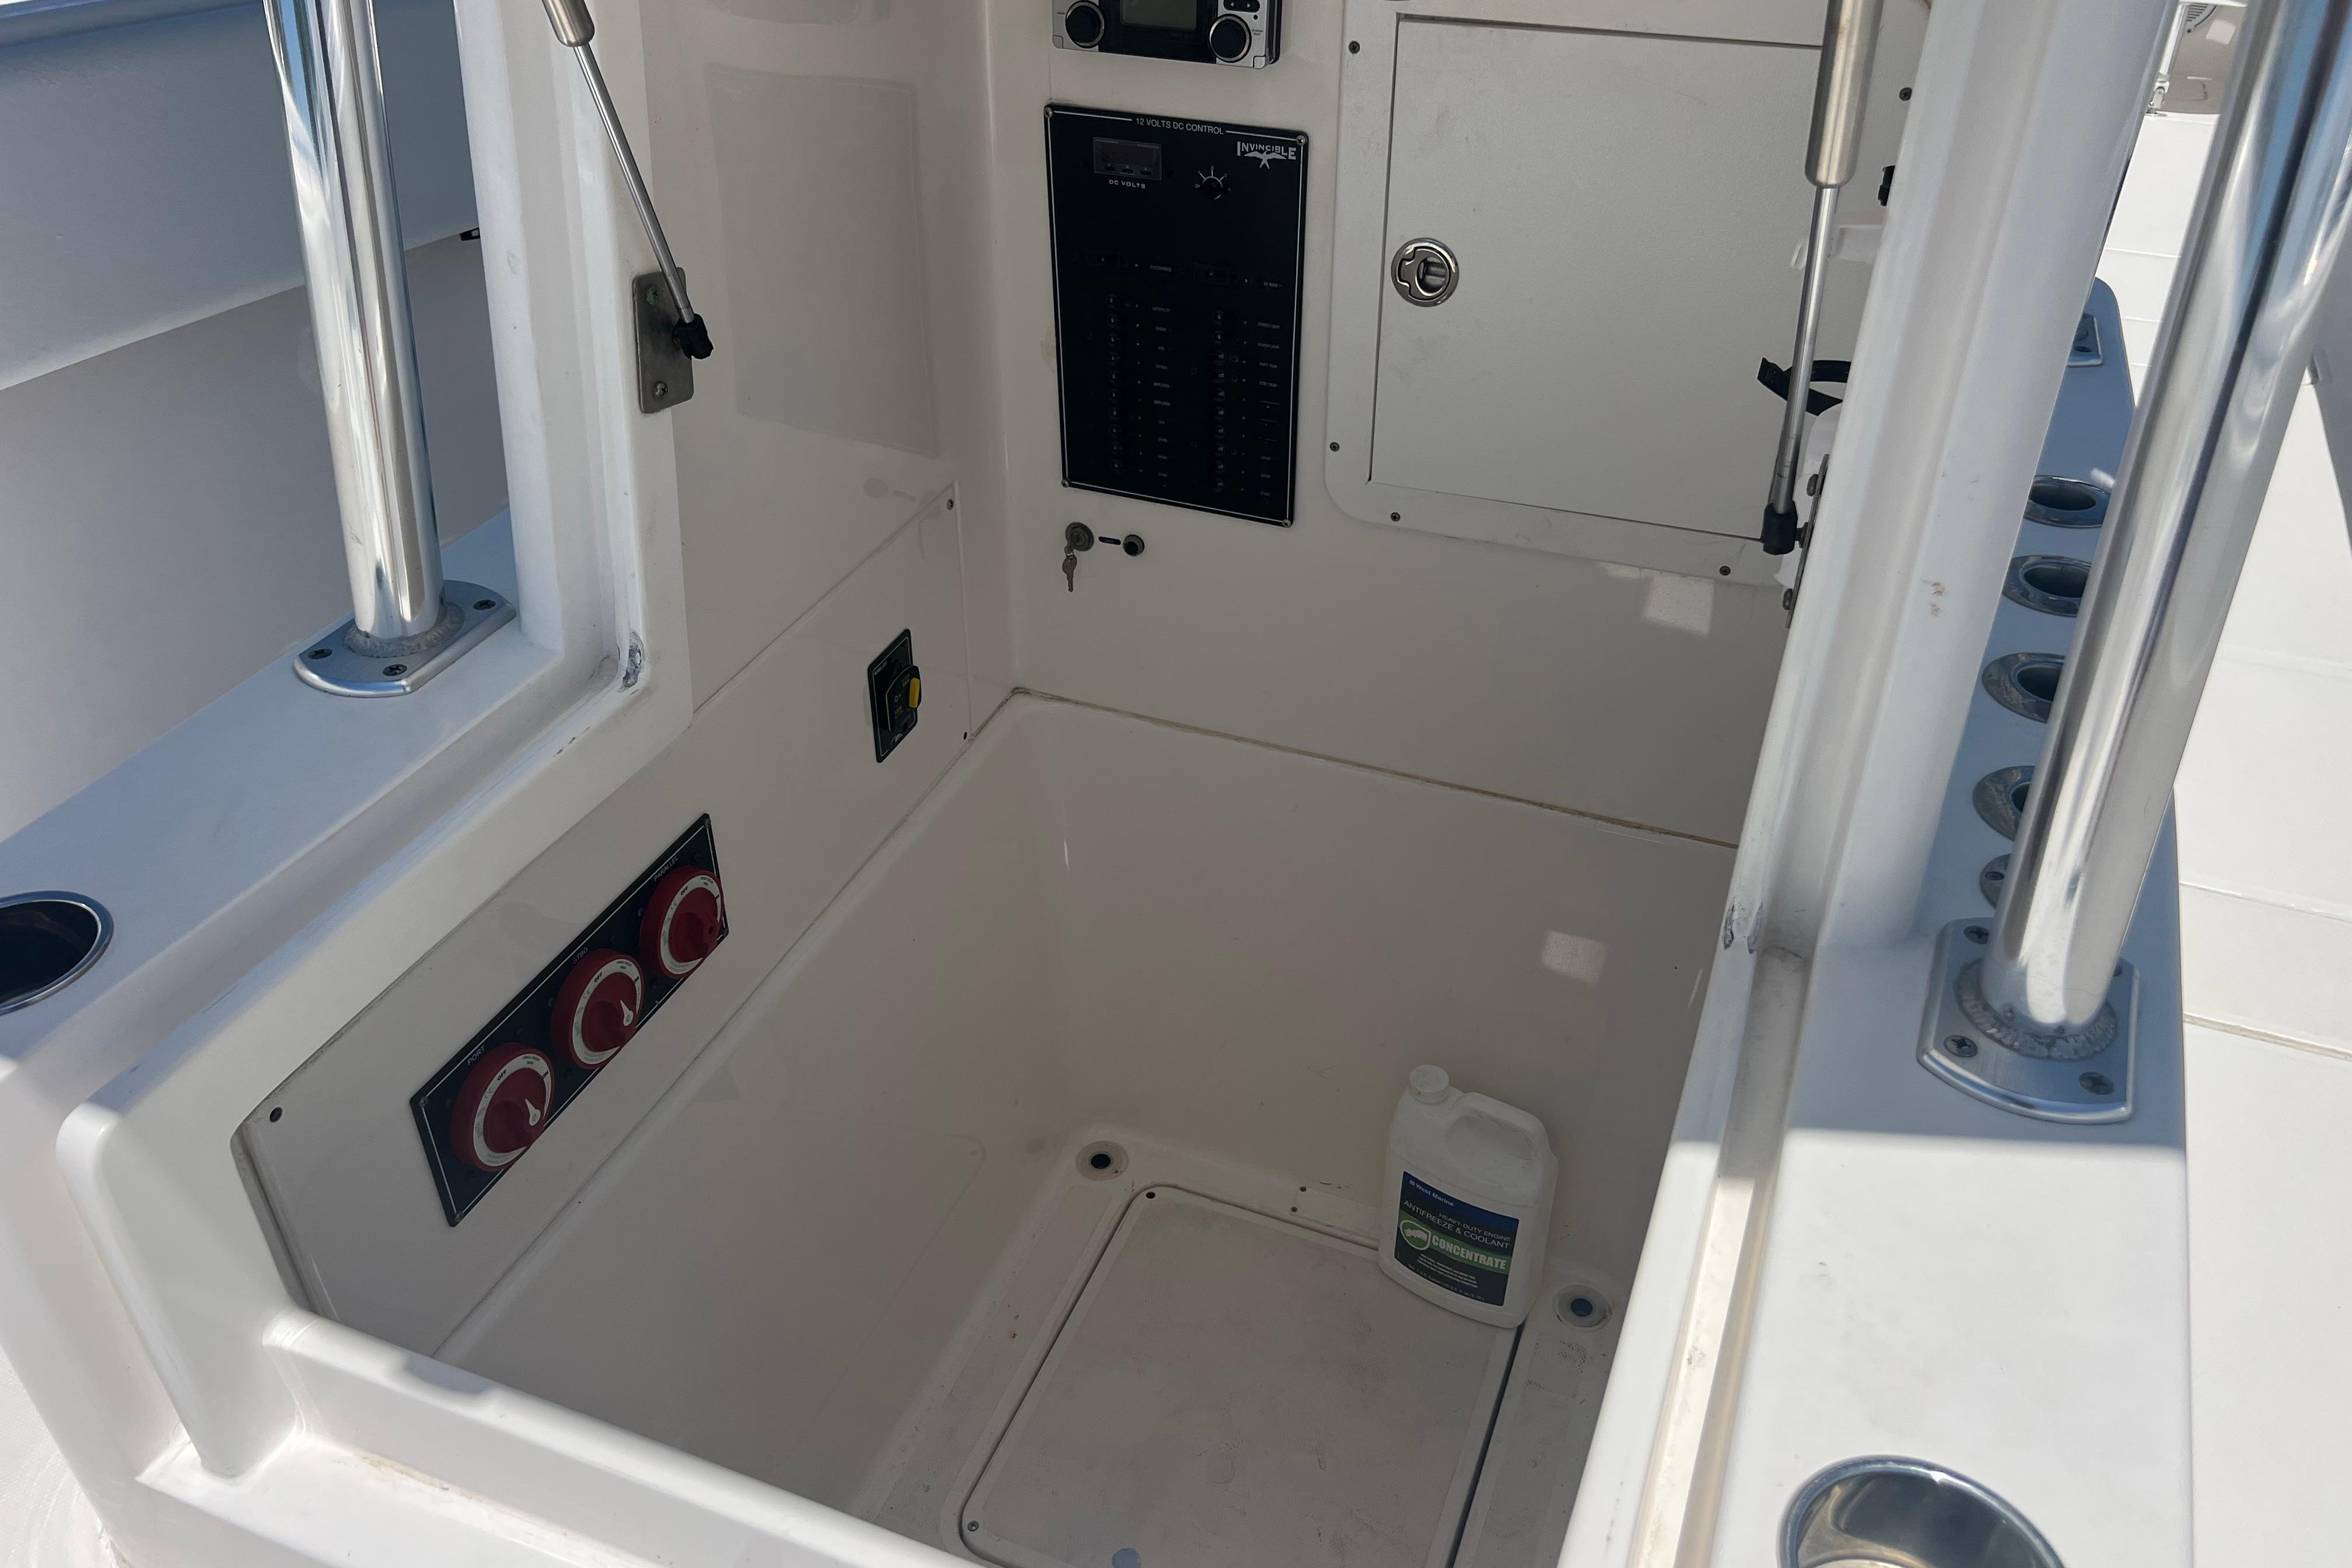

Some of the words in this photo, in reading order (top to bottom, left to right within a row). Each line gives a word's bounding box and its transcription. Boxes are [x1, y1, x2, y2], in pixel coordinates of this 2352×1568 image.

[1146, 118, 1171, 130] VOLTS
[1172, 121, 1185, 131] DC
[1186, 123, 1224, 135] CONTROL
[1236, 141, 1297, 160] INVINCIBLE
[1121, 180, 1146, 189] VOLTS
[653, 856, 679, 882] PARALLEL
[572, 947, 588, 964] STBD
[594, 971, 603, 983] OFF
[467, 1045, 485, 1066] PORT
[497, 1069, 507, 1081] OFF
[1416, 1183, 1431, 1196] West
[1432, 1192, 1454, 1206] Marine
[1404, 1200, 1454, 1231] ANTIFREEZE
[1455, 1227, 1461, 1235] &
[1464, 1230, 1510, 1249] COOLANT
[1483, 1230, 1511, 1241] ENGINE
[1431, 1235, 1507, 1270] CONCENTRATE
